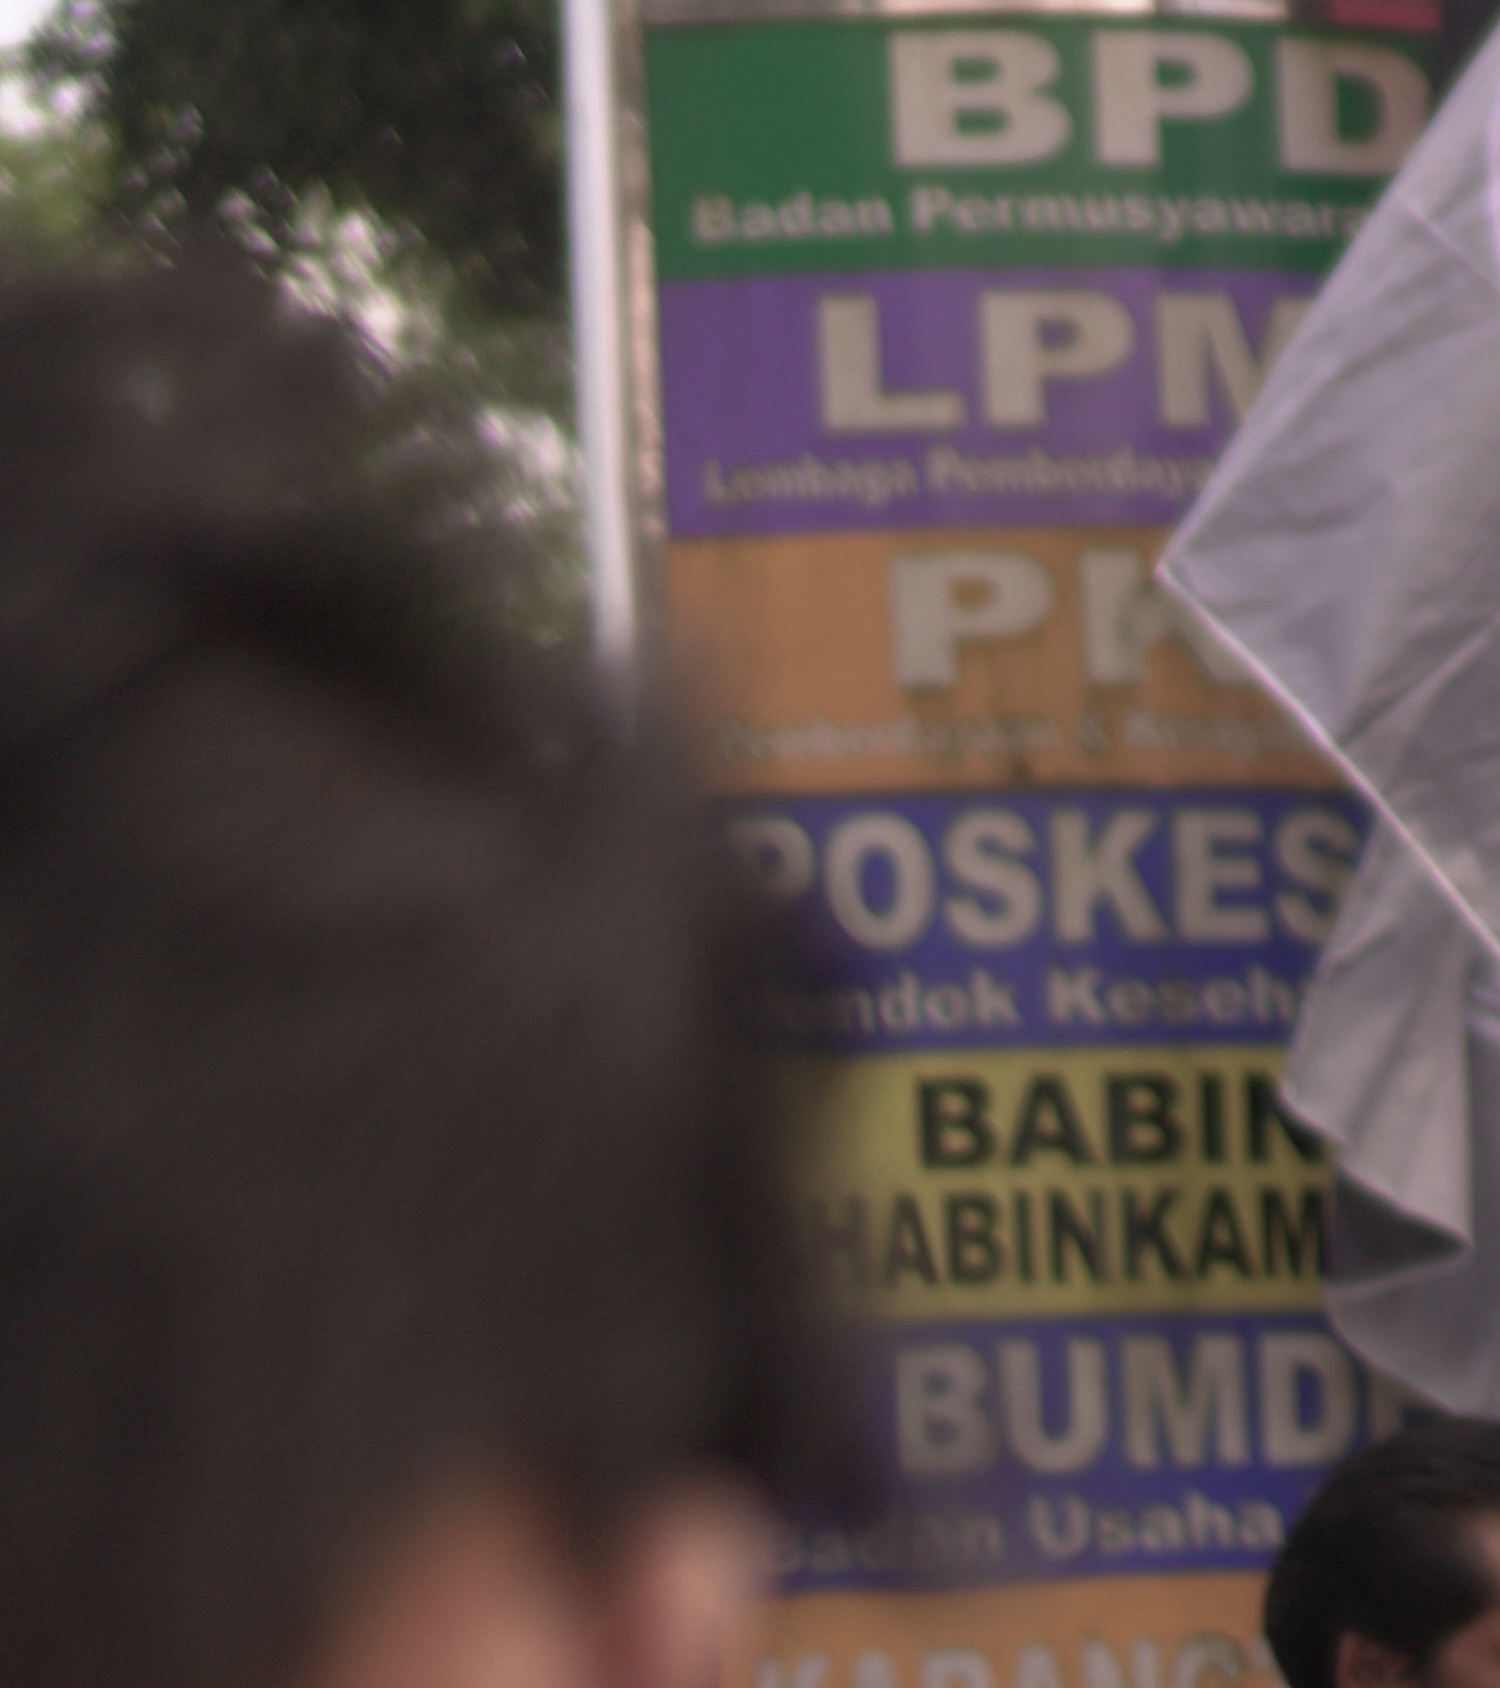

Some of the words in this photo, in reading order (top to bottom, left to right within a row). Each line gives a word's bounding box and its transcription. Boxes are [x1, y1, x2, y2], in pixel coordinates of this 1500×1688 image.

[888, 30, 1432, 175] BPD
[691, 192, 893, 246] Badan
[1026, 1494, 1286, 1558] Usaha
